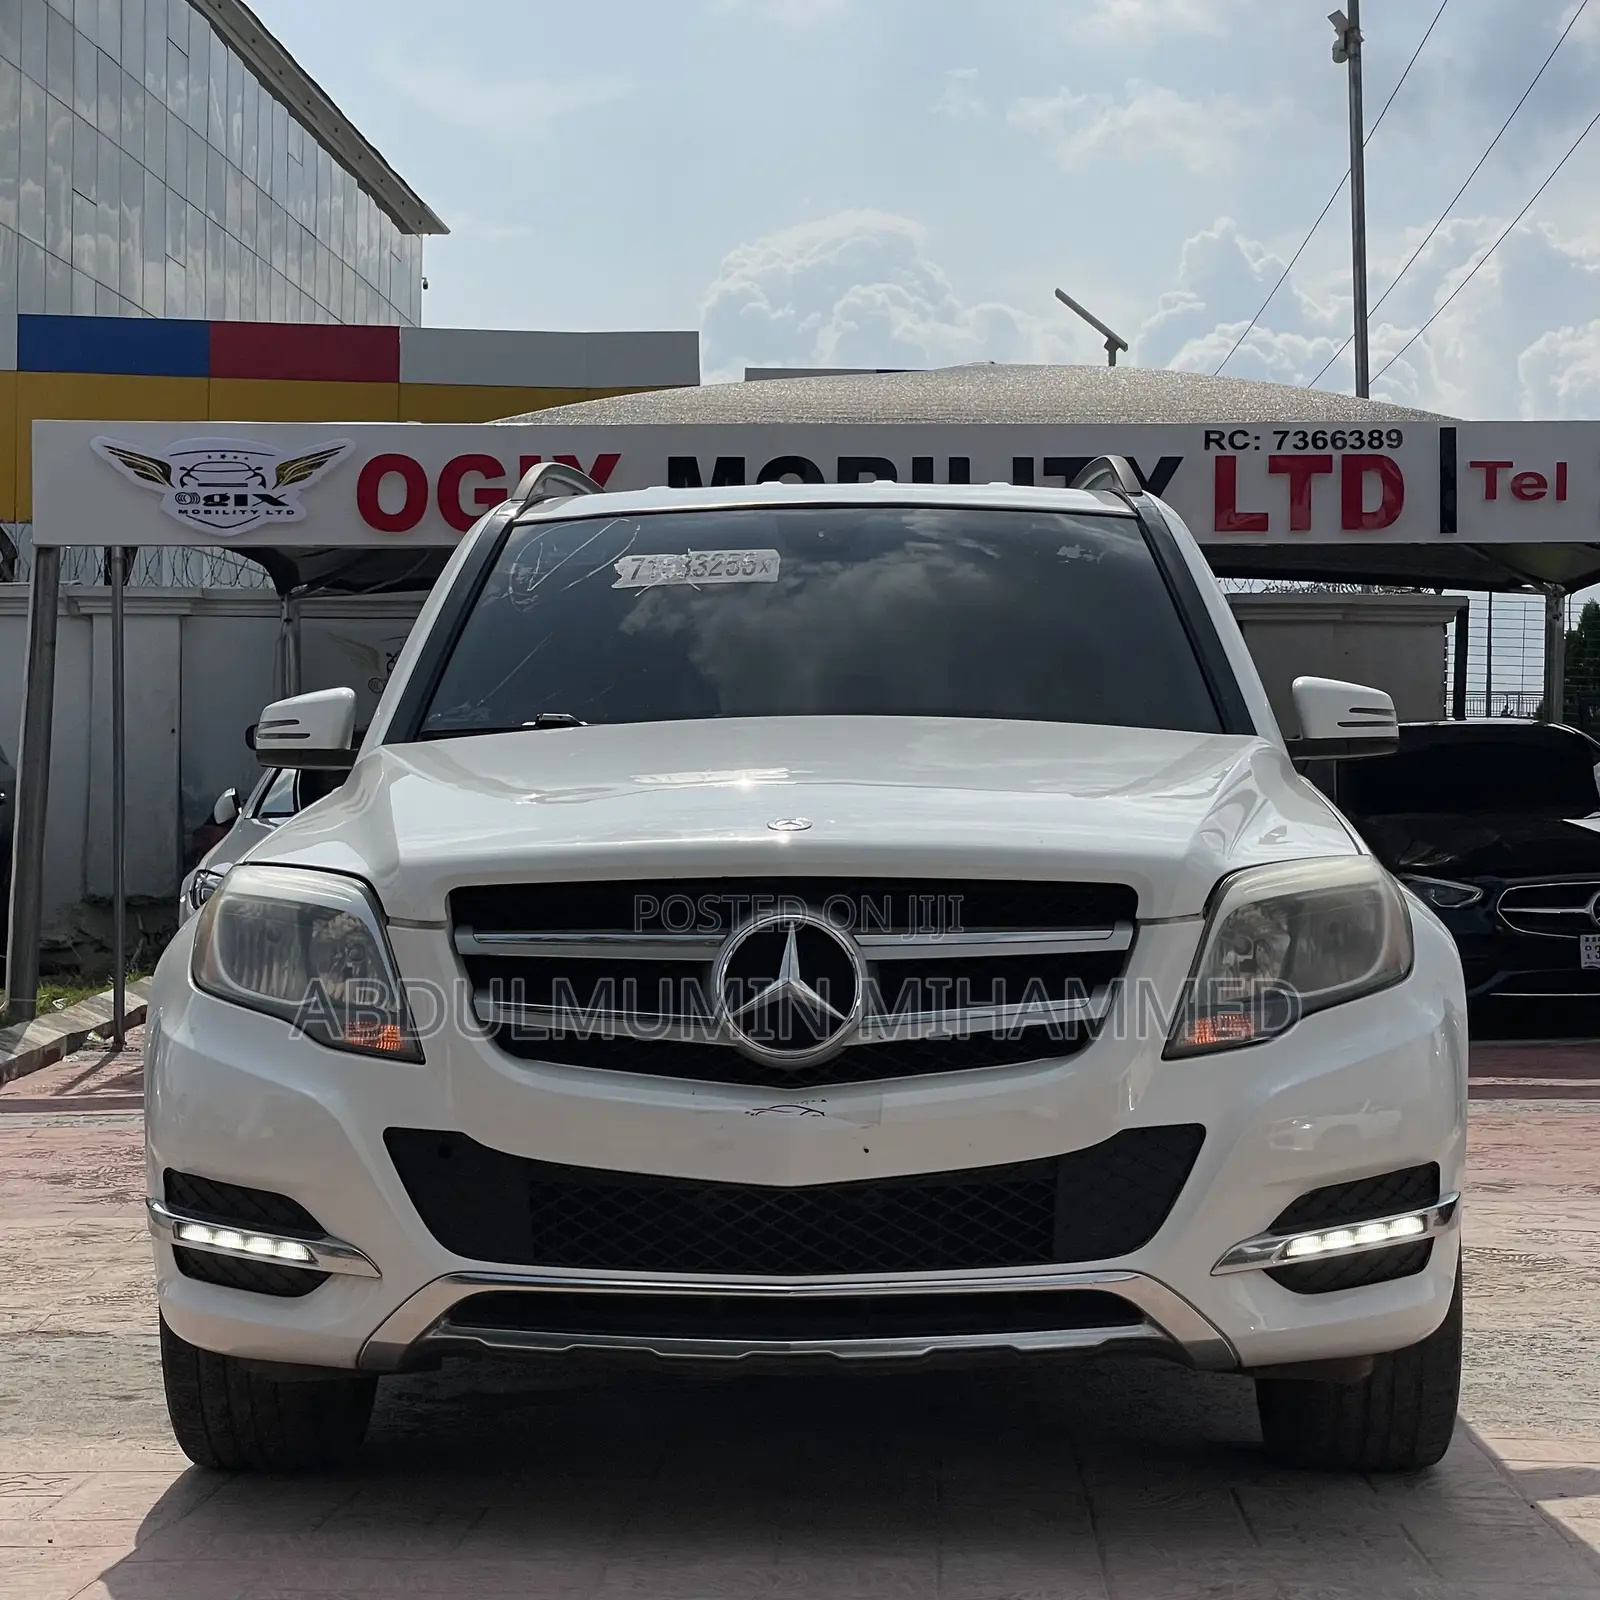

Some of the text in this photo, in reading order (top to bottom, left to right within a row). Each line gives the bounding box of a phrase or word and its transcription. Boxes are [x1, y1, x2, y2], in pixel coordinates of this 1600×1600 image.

[1204, 429, 1404, 451] RC: 7366389
[1214, 454, 1405, 532] LTD
[1469, 461, 1568, 501] Tel
